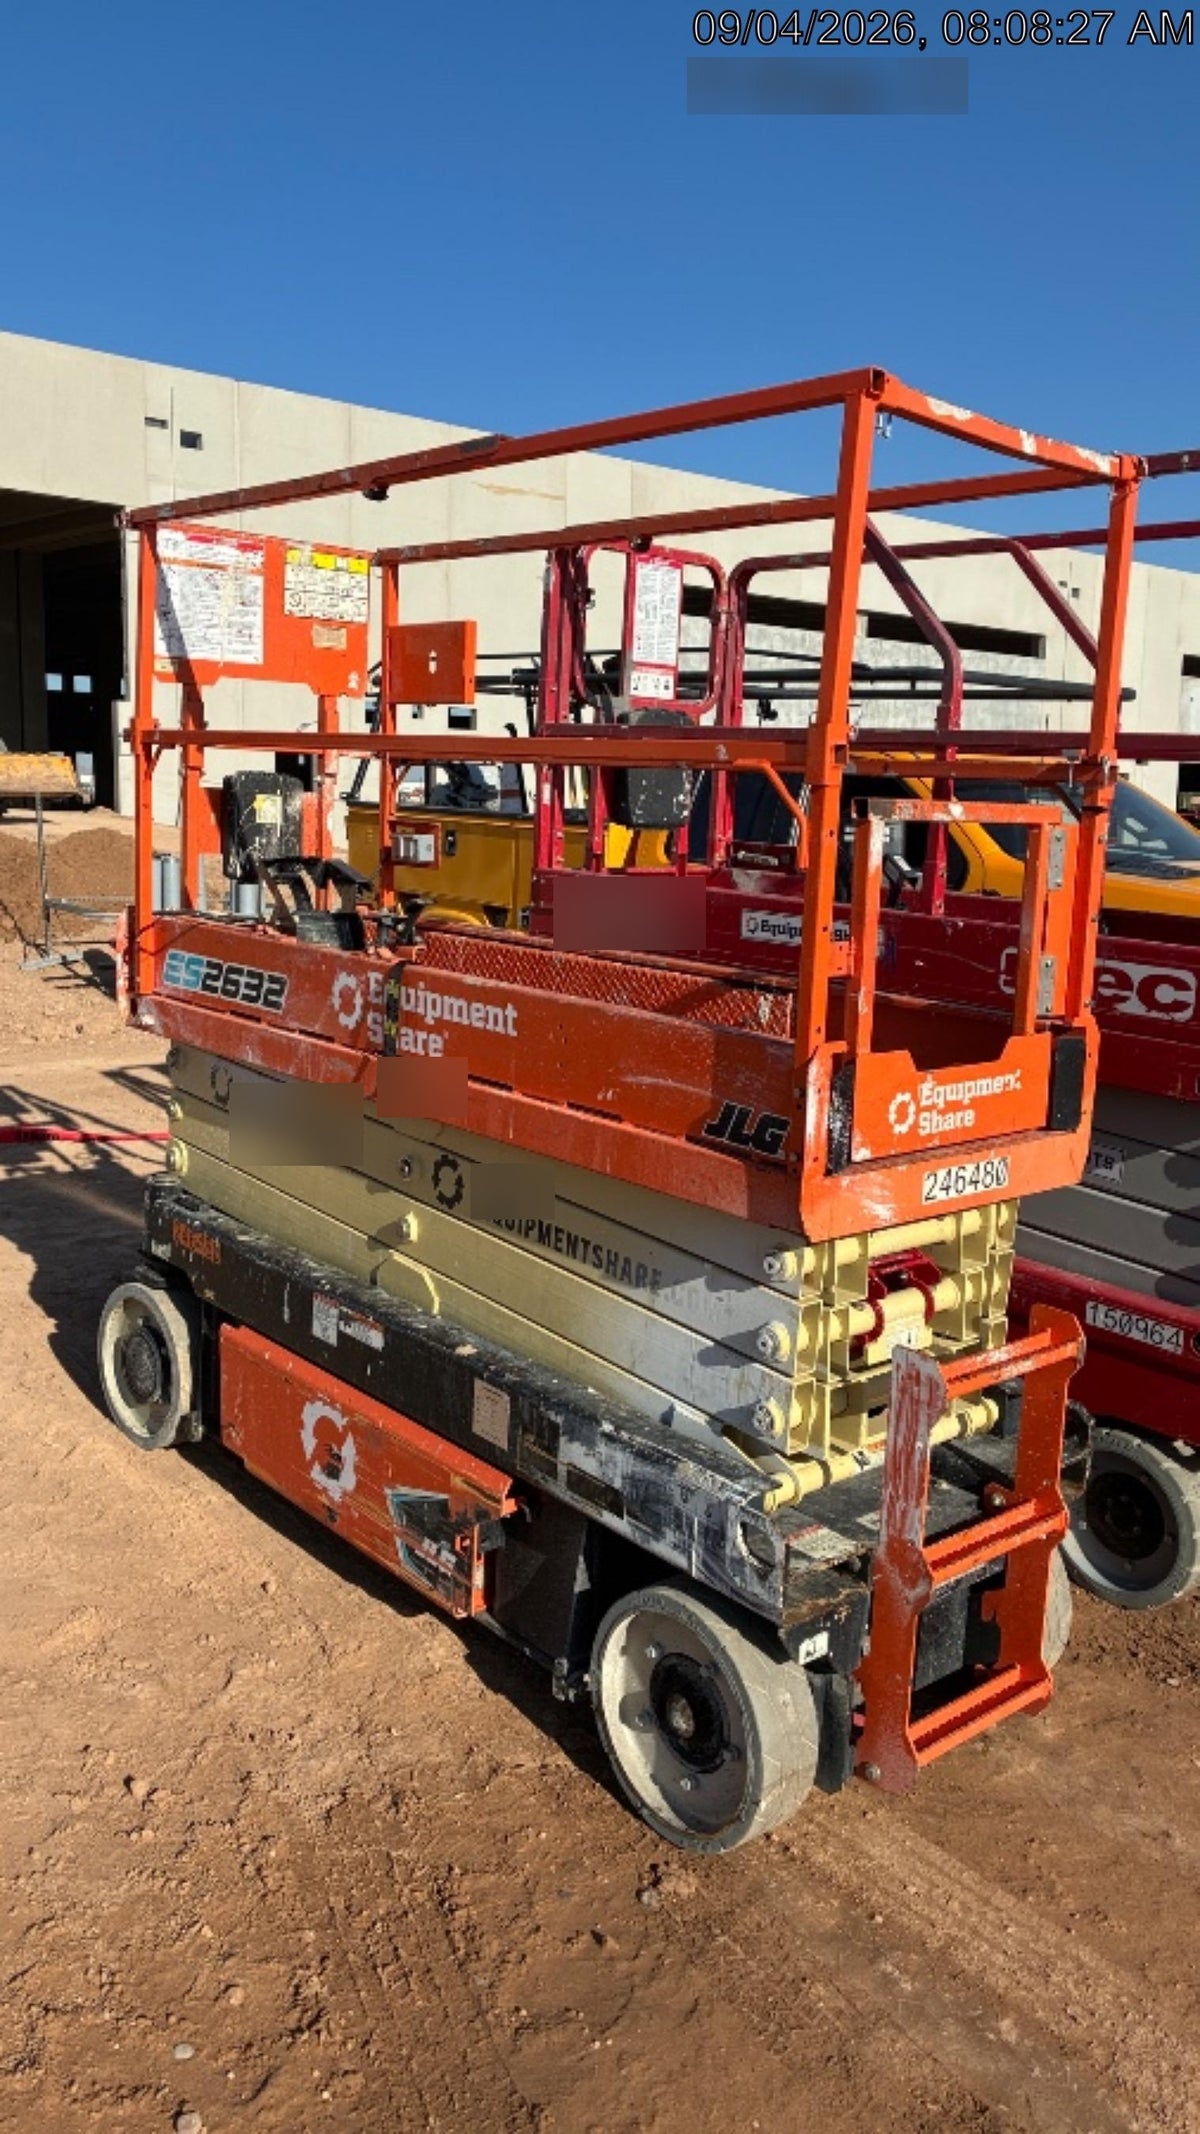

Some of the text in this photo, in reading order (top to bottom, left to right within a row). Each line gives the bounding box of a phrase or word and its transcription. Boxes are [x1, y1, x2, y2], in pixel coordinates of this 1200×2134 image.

[163, 949, 289, 1013] ES2632
[368, 972, 518, 1036] Euipment
[368, 1009, 444, 1058] Sare
[702, 1100, 792, 1159] JLG
[918, 1109, 976, 1136] Share
[924, 1156, 1009, 1202] 246480
[1089, 1303, 1182, 1349] 150964
